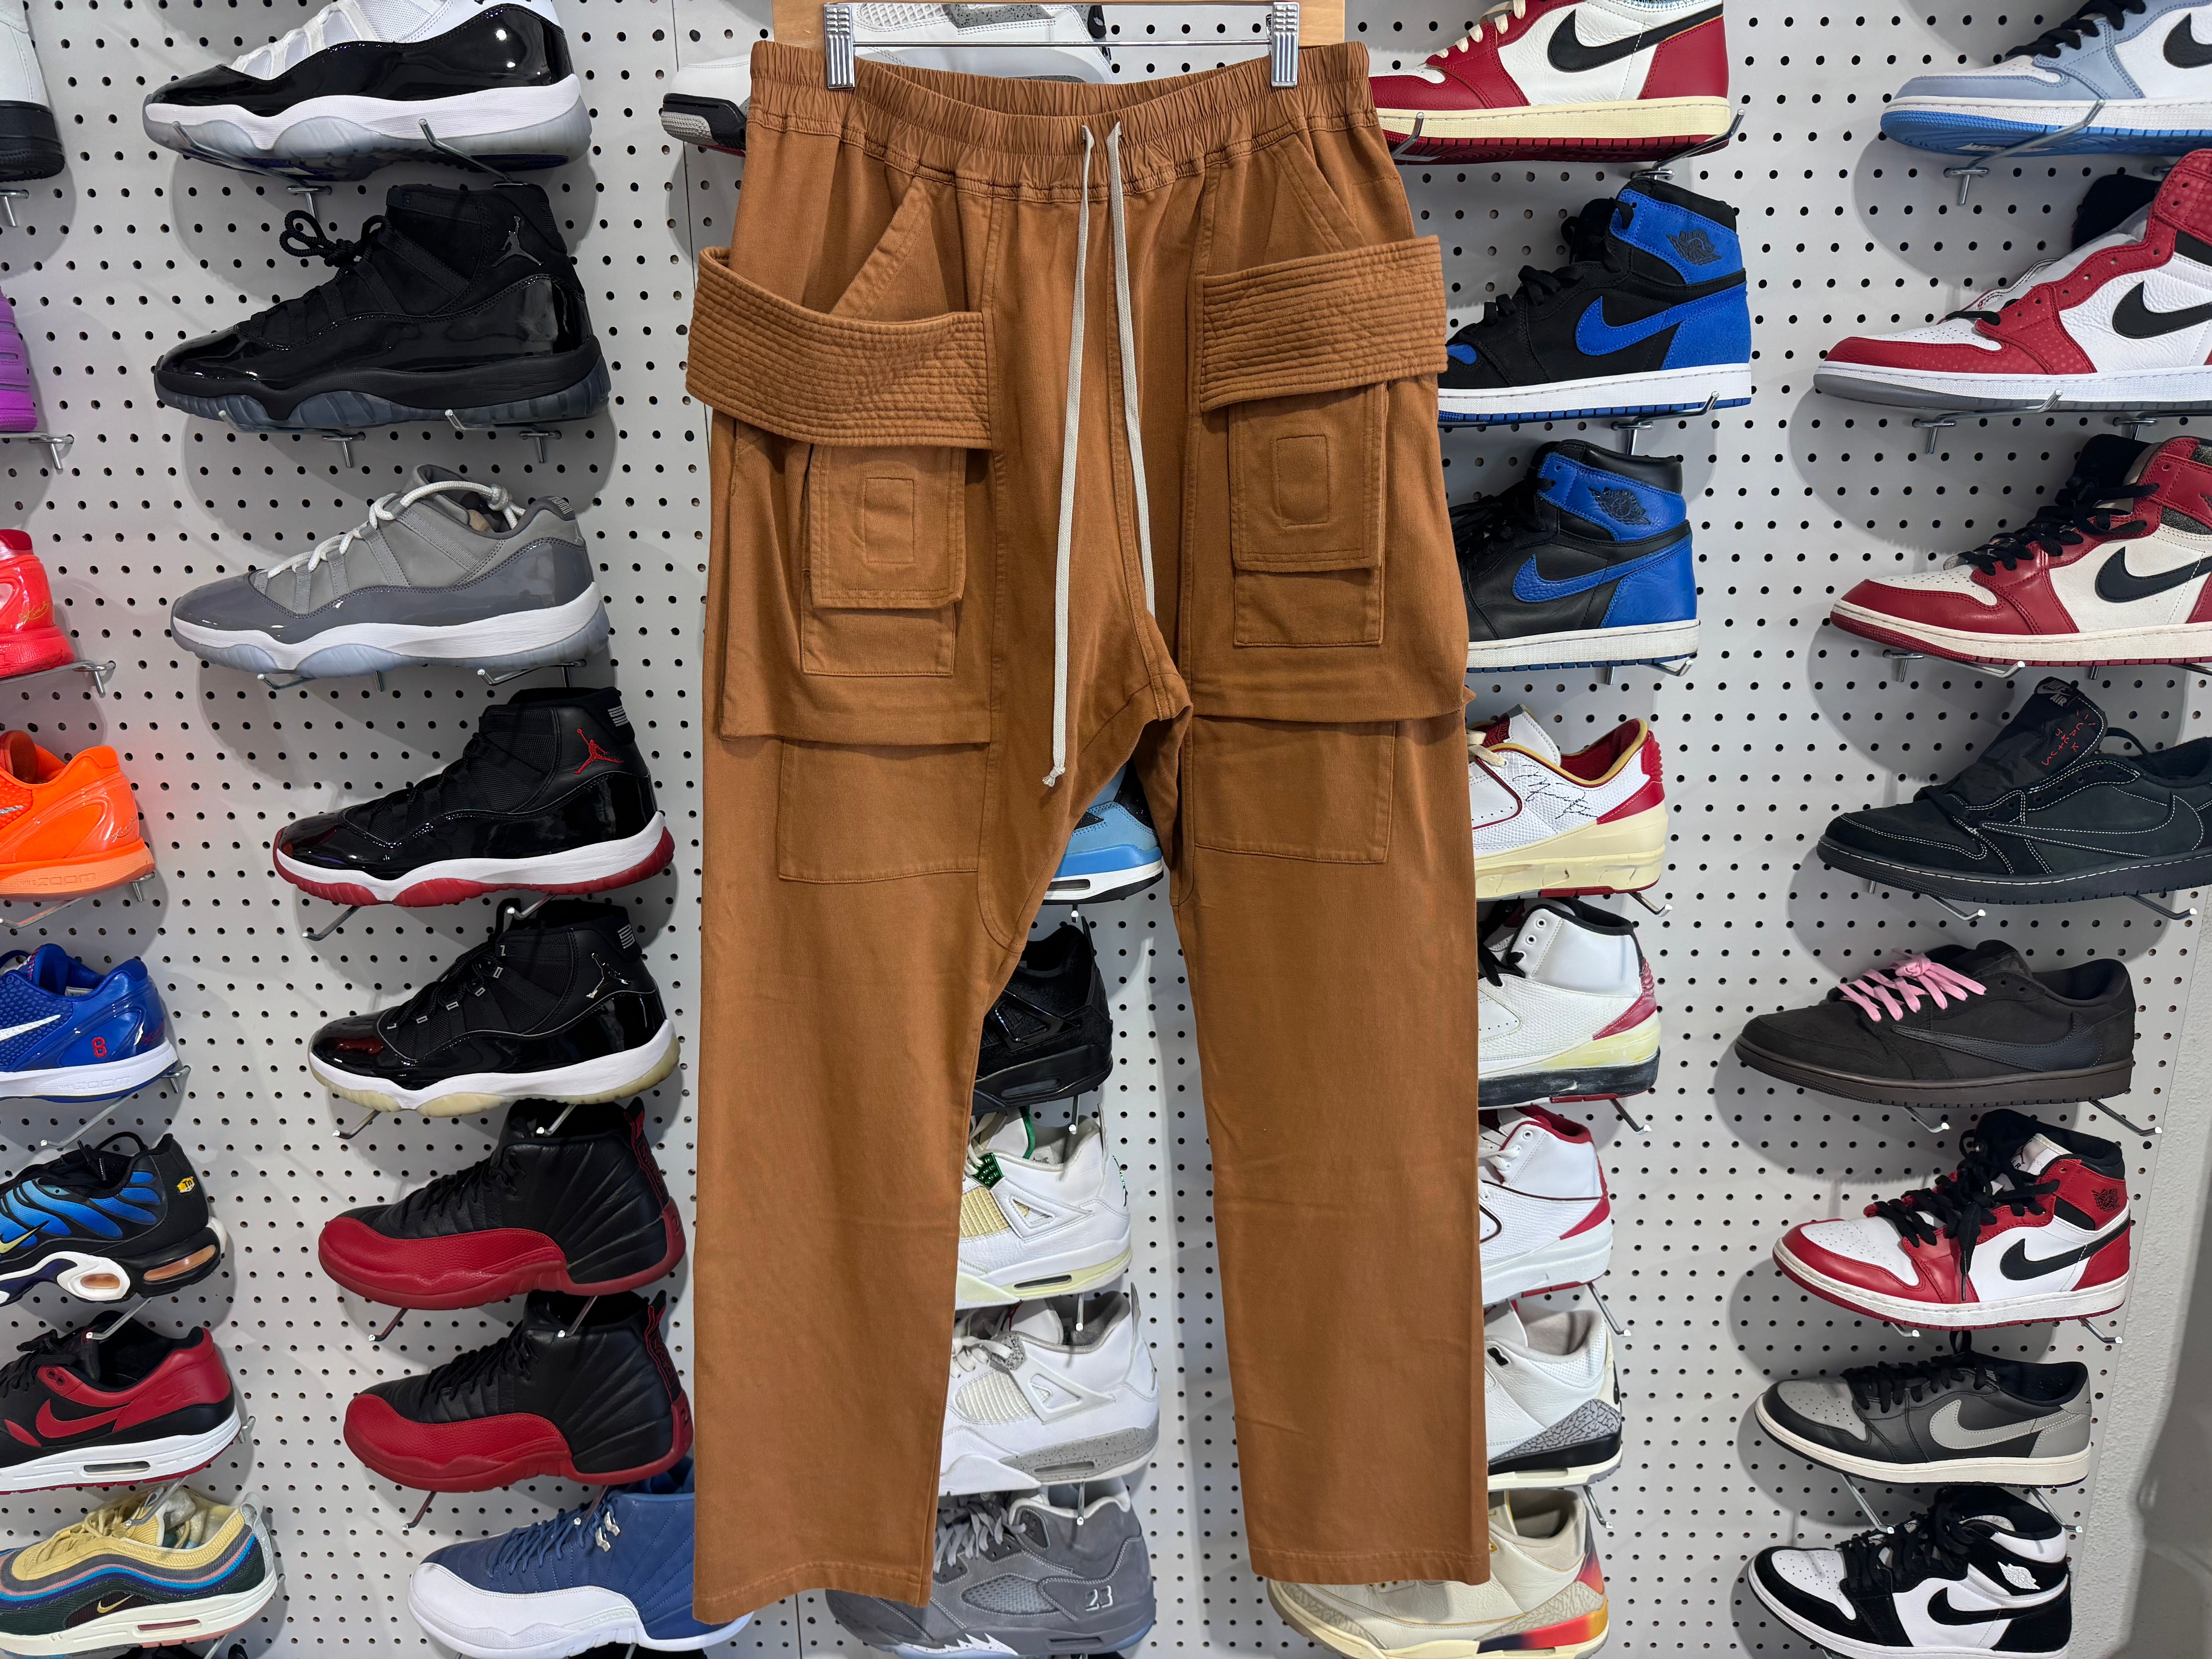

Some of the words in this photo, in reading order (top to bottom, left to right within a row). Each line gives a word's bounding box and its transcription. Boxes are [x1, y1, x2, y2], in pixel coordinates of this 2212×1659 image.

[2043, 679, 2071, 694] NIKE
[2050, 694, 2067, 707] AIR
[91, 1037, 107, 1057] 8
[1085, 1585, 1113, 1611] 23
